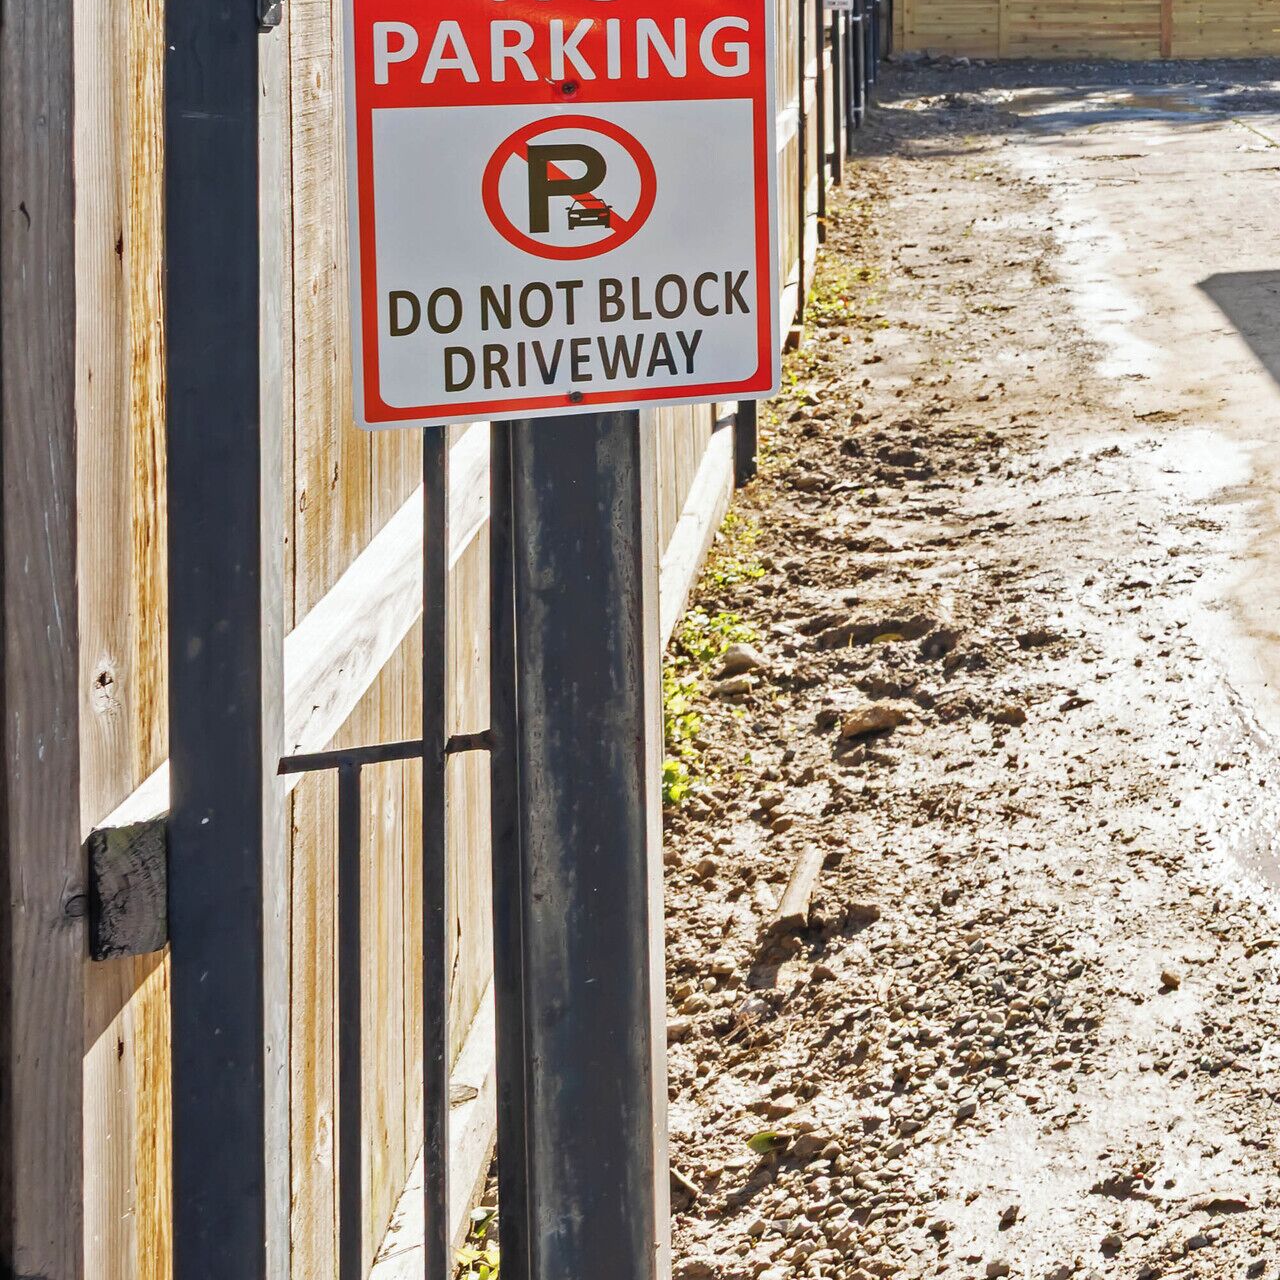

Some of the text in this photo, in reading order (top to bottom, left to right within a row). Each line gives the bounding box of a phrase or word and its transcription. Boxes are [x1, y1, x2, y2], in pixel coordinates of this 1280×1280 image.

[372, 16, 750, 85] PARKING
[389, 270, 751, 337] DO NOT BLOCK
[443, 329, 703, 392] DRIVEWAY
